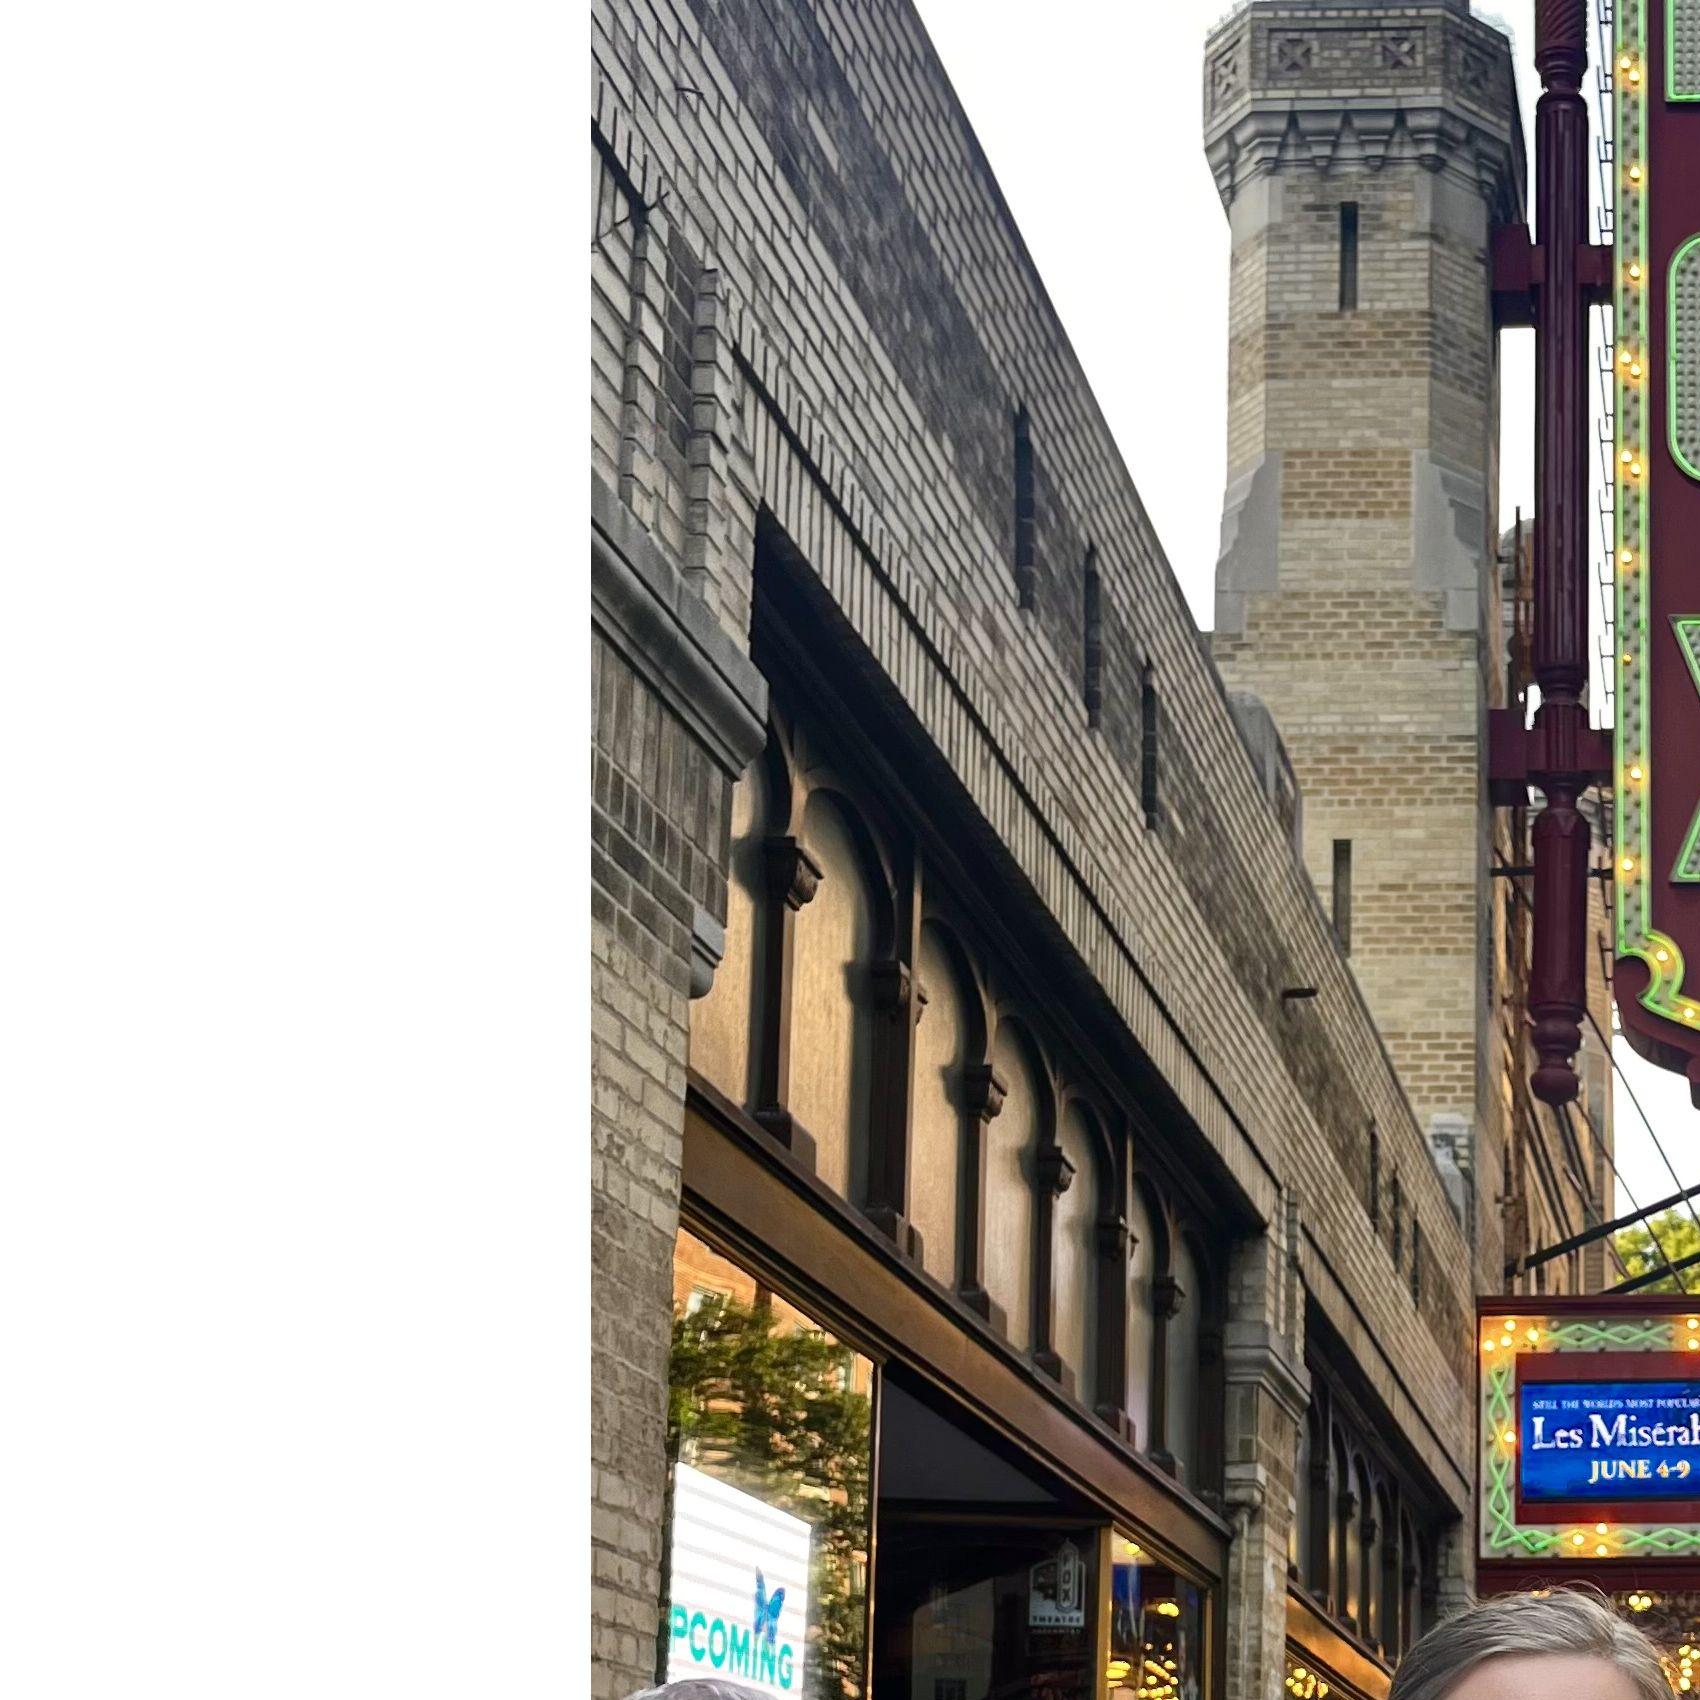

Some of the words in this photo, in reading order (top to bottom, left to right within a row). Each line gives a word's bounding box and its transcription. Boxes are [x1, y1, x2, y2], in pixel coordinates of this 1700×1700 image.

[1561, 1399, 1579, 1409] THE
[1532, 1416, 1583, 1450] Les
[1587, 1460, 1652, 1485] JUNE
[1656, 1459, 1691, 1479] 4-9
